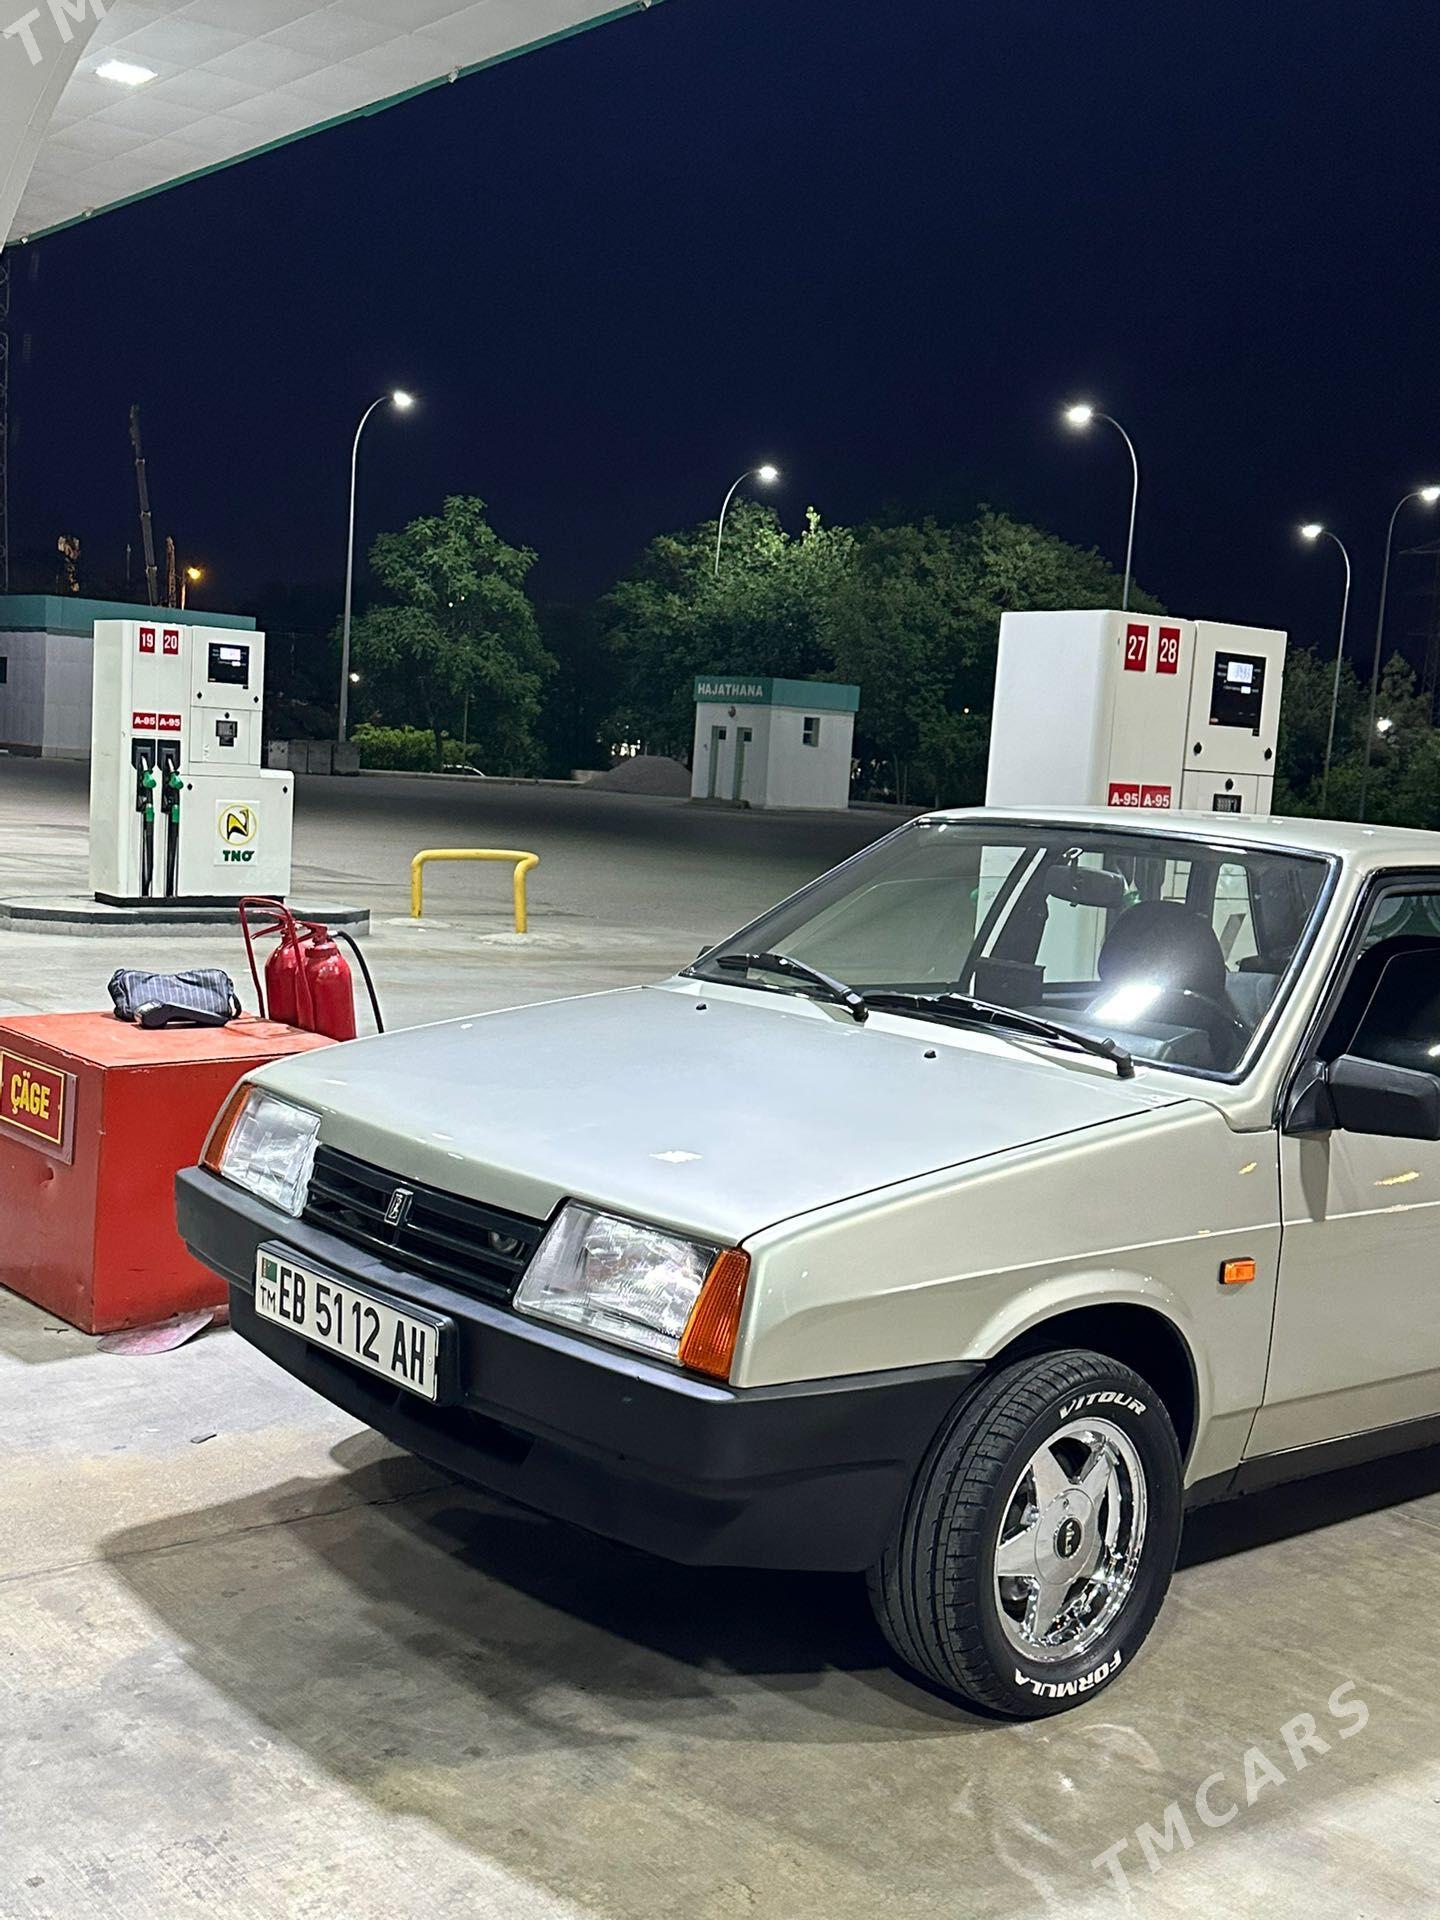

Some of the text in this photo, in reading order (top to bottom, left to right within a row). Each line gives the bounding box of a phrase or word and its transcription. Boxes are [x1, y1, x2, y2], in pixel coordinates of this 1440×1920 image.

[142, 634, 154, 648] 19
[164, 635, 178, 649] 20
[1127, 635, 1146, 662] 27
[1159, 638, 1177, 664] 28
[697, 682, 763, 697] HAJATHANA
[1110, 791, 1138, 806] A-95
[1142, 793, 1170, 808] A-95
[10, 1070, 51, 1120] ÇÄGE
[260, 1285, 277, 1314] TM
[279, 1266, 306, 1325] EB
[391, 1320, 426, 1385] AH
[1058, 1391, 1147, 1421] VITOUR
[1015, 1650, 1123, 1699] FORMULA
